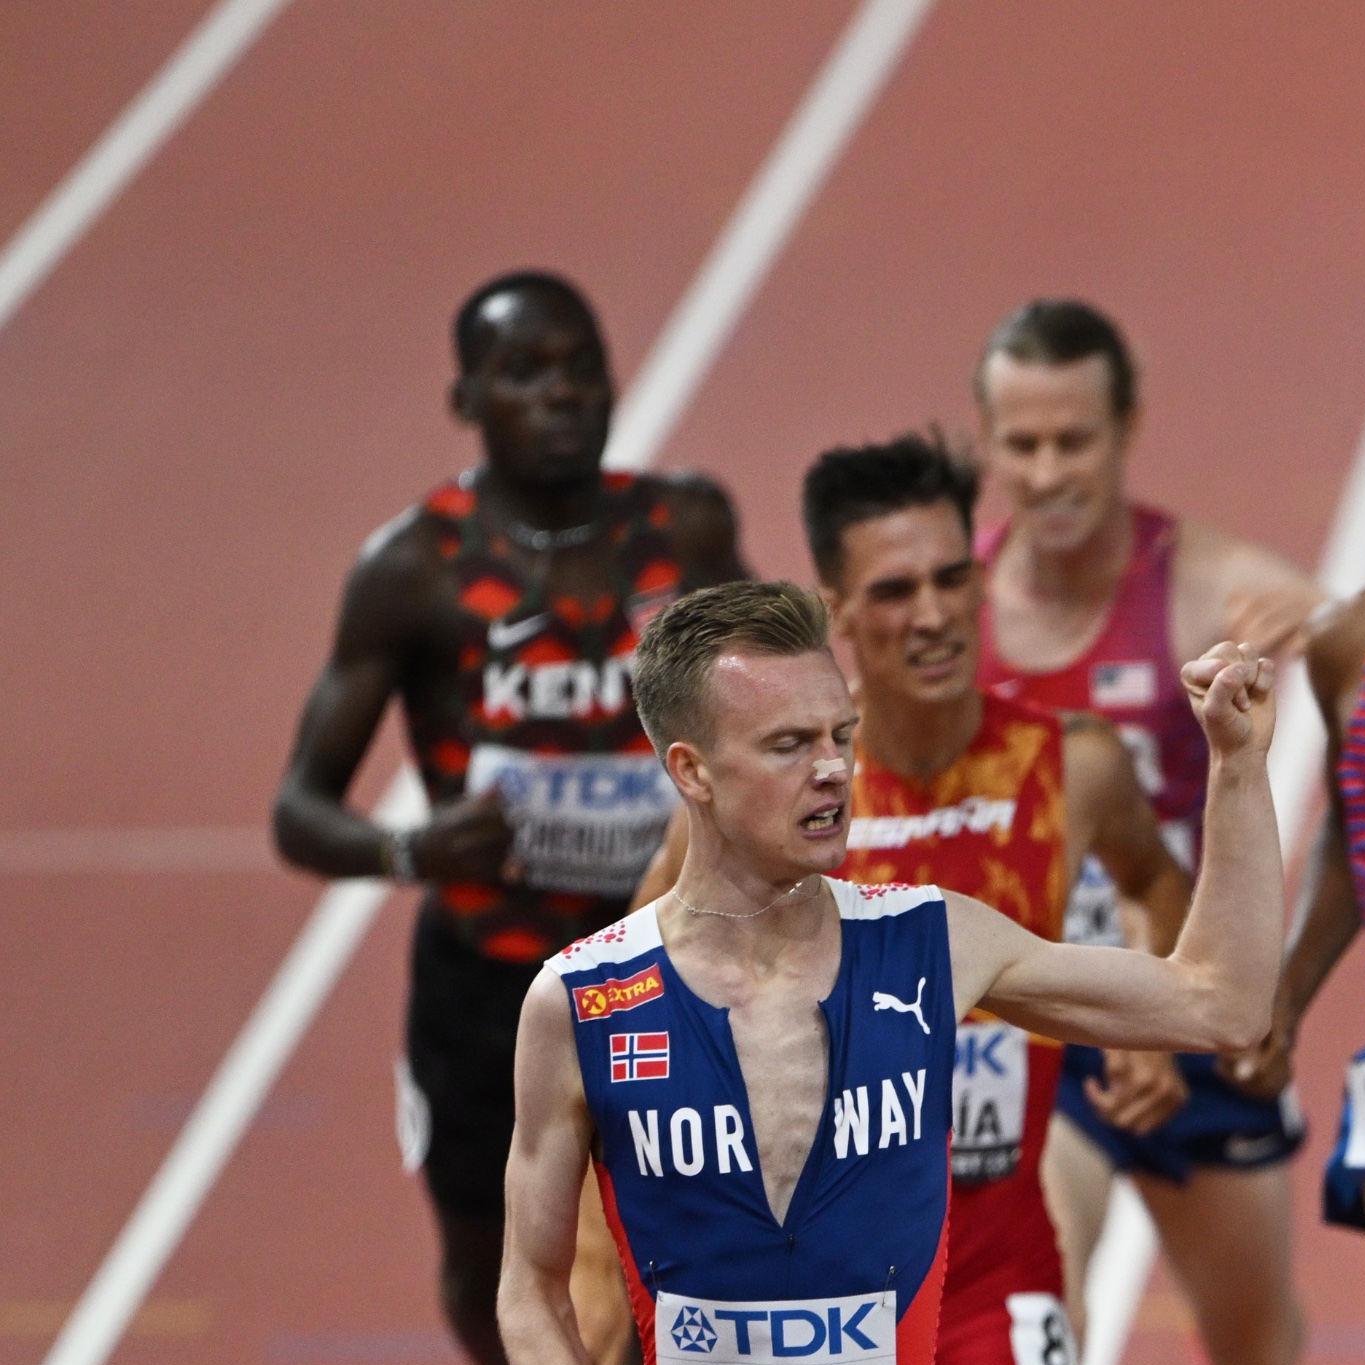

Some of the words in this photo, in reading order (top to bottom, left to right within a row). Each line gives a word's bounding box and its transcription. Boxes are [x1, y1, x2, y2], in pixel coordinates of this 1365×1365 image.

[483, 658, 640, 721] KEN
[608, 977, 659, 1002] EXTRA
[715, 1302, 879, 1357] TDK
